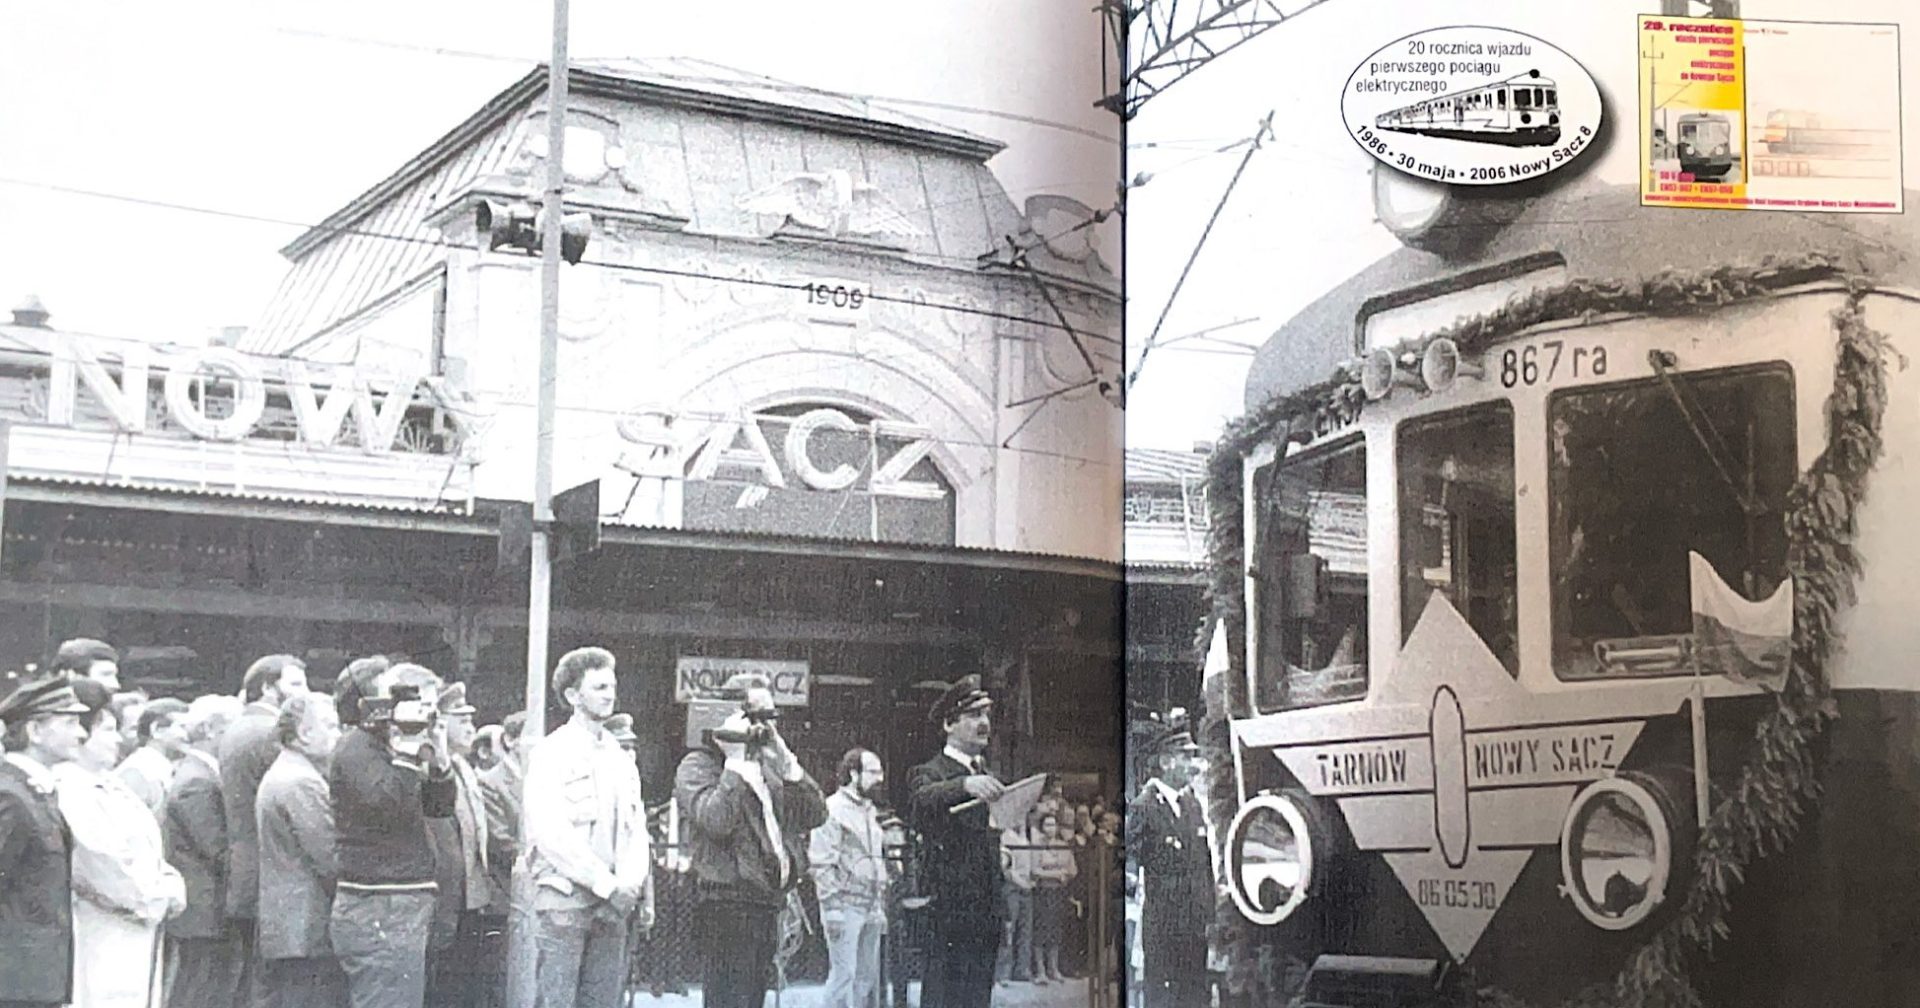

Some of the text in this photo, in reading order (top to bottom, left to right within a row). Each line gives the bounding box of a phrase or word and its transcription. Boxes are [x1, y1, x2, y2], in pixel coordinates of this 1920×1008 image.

[804, 282, 864, 309] 1909
[1316, 733, 1615, 787] TARNÓW NOWY SĄCZ
